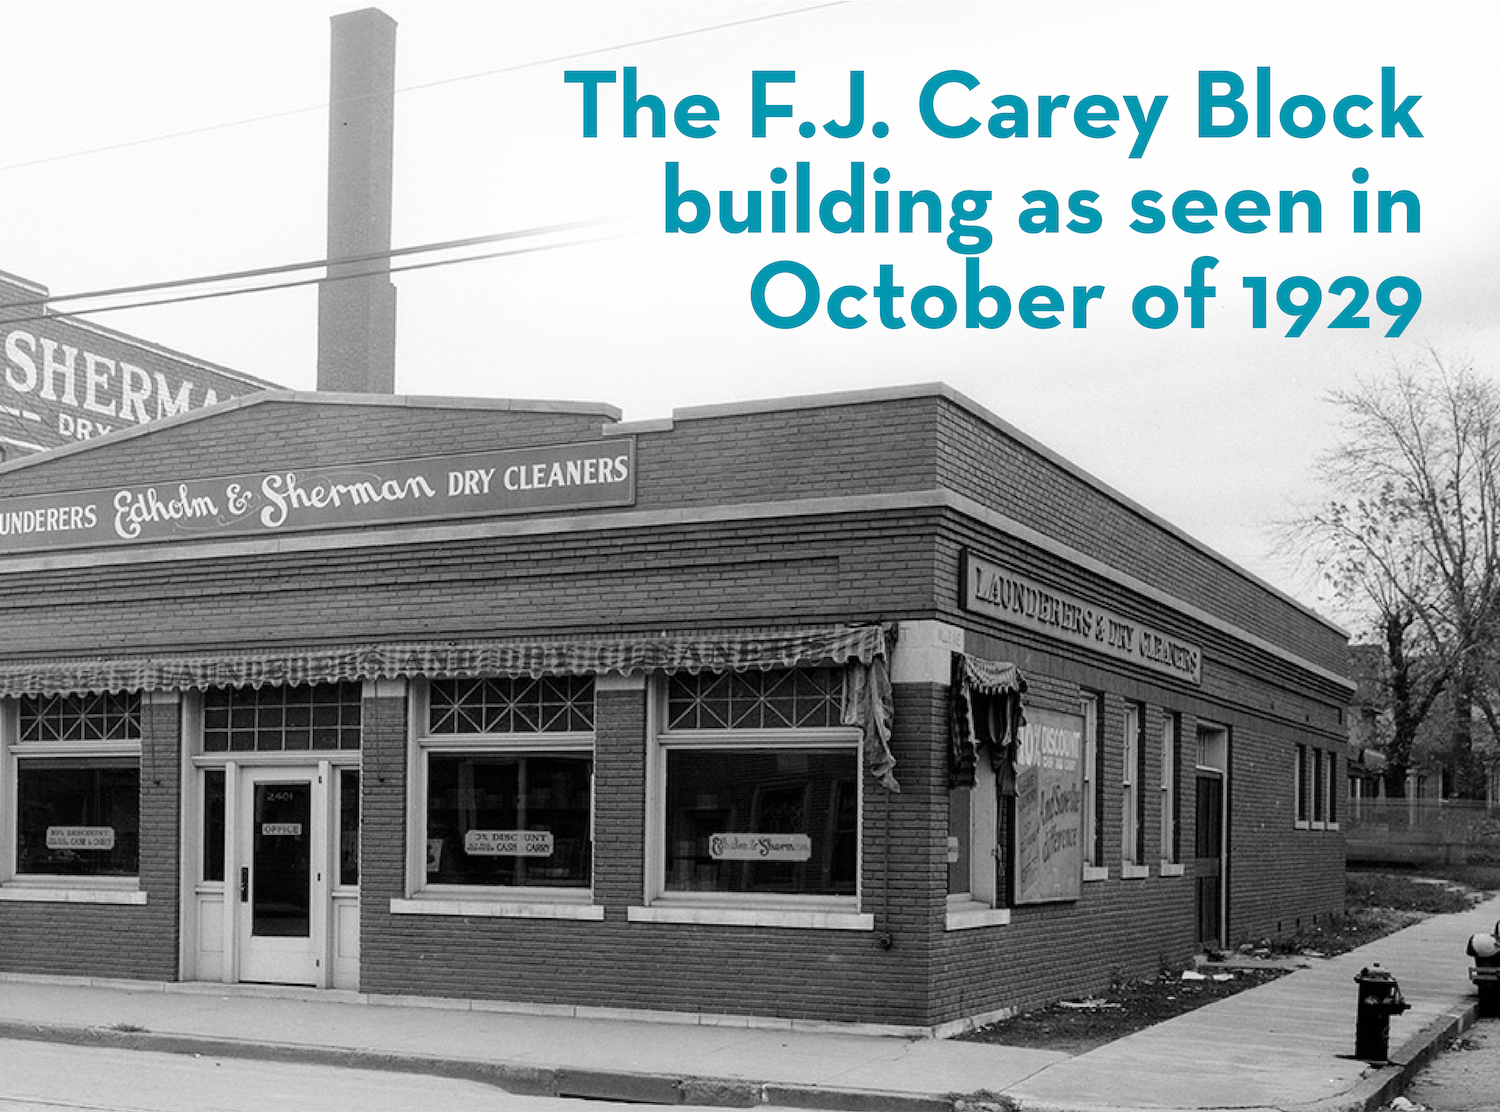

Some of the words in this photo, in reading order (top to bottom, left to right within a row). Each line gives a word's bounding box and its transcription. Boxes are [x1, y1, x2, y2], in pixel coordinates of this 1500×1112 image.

[5, 329, 238, 421] SHERM
[59, 412, 112, 441] DRY
[113, 484, 219, 539] Edholm
[225, 482, 254, 516] &
[260, 471, 437, 528] Sherman
[448, 467, 496, 497] DRY
[503, 455, 629, 491] CLEANERS
[974, 566, 1093, 637] LAUNDERERS
[1094, 615, 1106, 641] &
[1107, 618, 1135, 653] DRY
[1139, 631, 1198, 675] CLEANERS
[266, 792, 293, 801] 2401
[264, 824, 299, 834] OFFICE
[492, 833, 547, 842] DISCUNT
